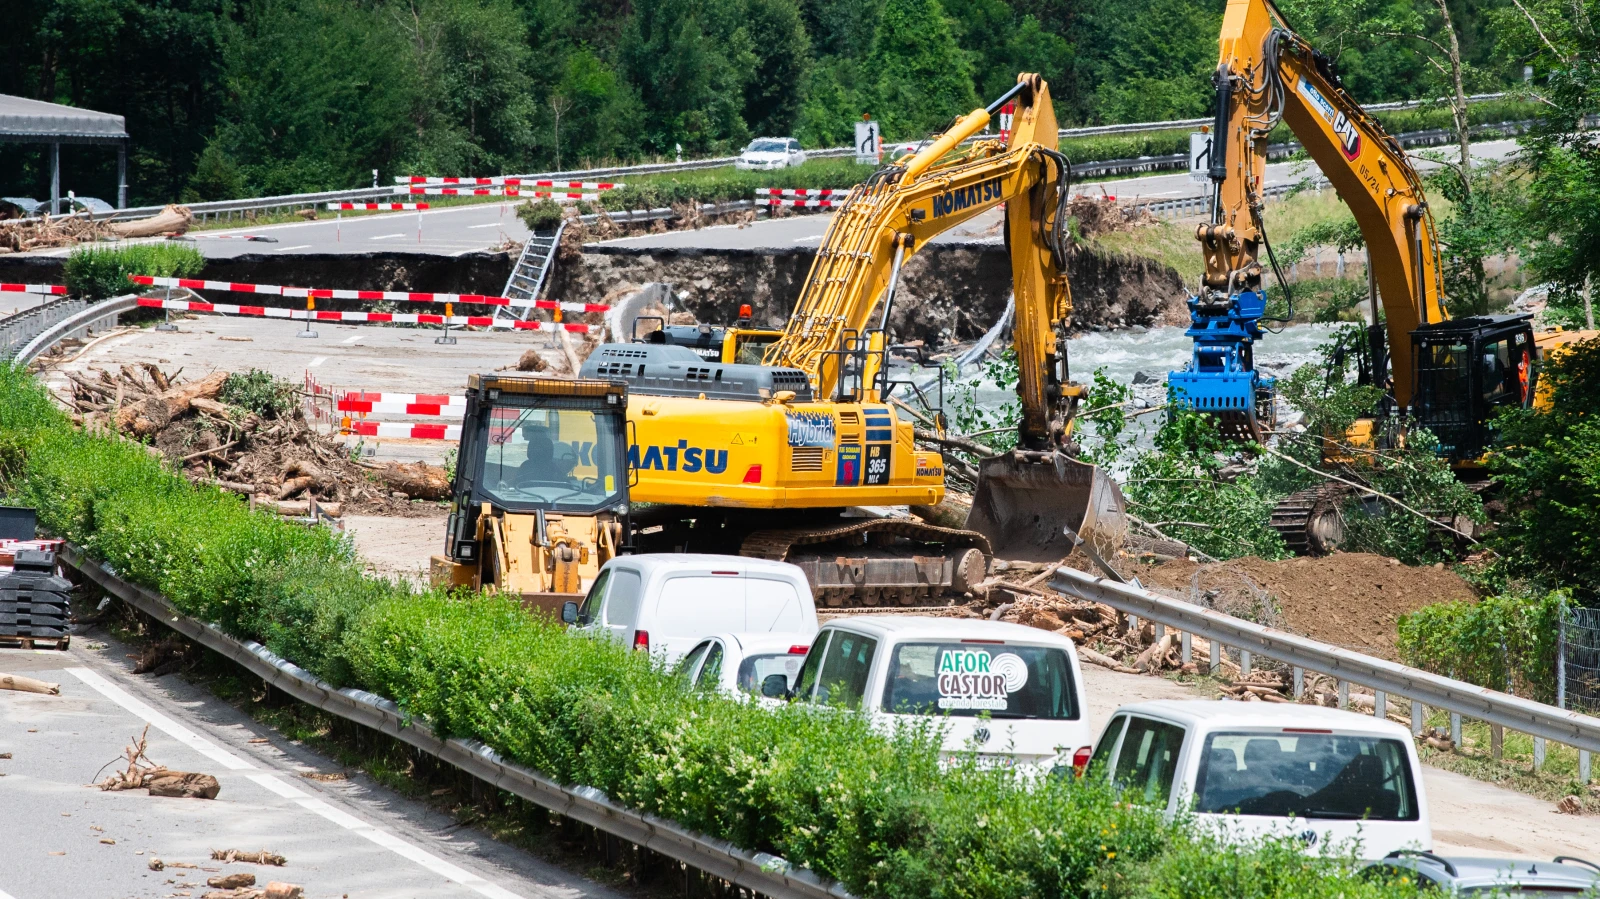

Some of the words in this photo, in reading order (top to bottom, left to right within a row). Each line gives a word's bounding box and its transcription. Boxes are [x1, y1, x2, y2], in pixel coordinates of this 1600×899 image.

[1333, 110, 1359, 151] CAT
[1359, 164, 1380, 194] 05/24
[932, 174, 1002, 218] KOMATSU
[789, 419, 833, 447] Hybrid
[870, 446, 880, 457] HB
[868, 459, 887, 474] 365
[916, 466, 942, 477] KOMATSU
[941, 652, 990, 673] AFOR
[940, 674, 1005, 695] CASTOR
[940, 698, 970, 707] azienda
[971, 698, 1007, 709] forestale
